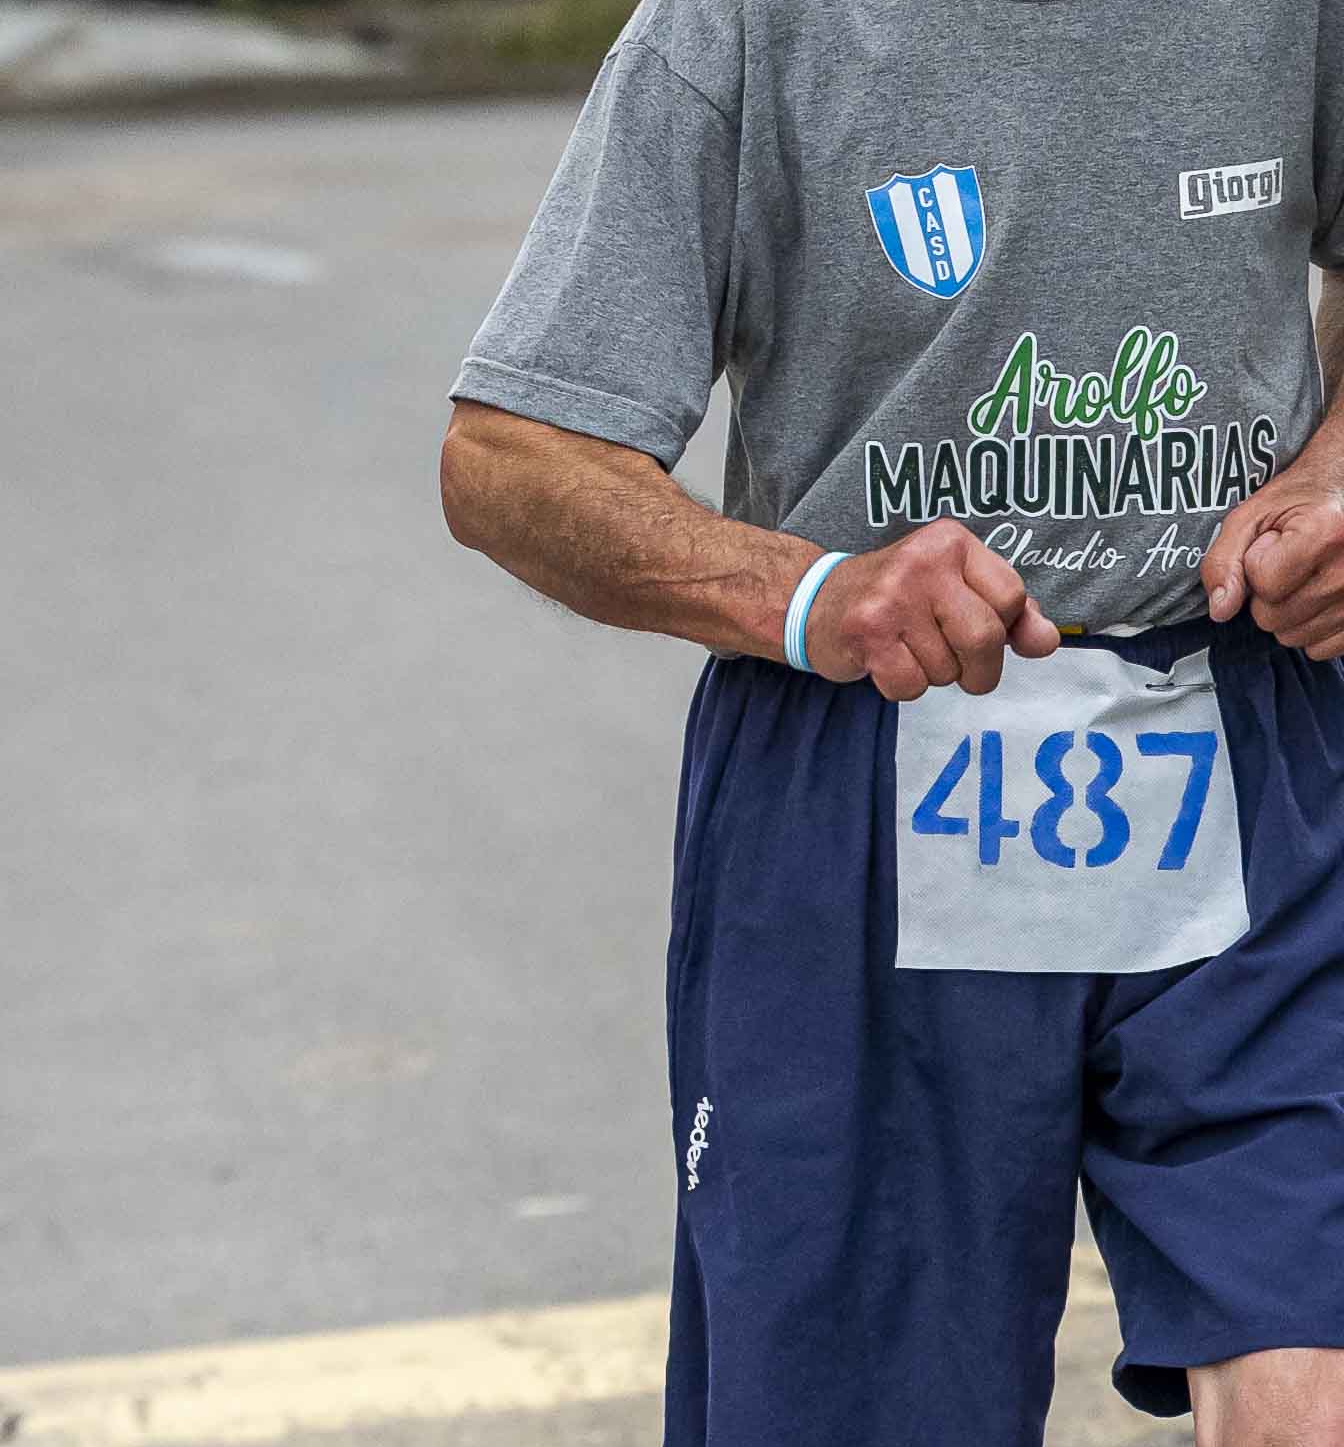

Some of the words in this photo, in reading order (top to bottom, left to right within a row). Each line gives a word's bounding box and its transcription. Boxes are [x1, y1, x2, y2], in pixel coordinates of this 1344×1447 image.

[917, 187, 951, 281] CASD
[967, 325, 1207, 441] Arolfo
[865, 415, 1278, 528] MAQUINARIAS
[984, 522, 1126, 572] Claudio
[911, 729, 1218, 870] 487
